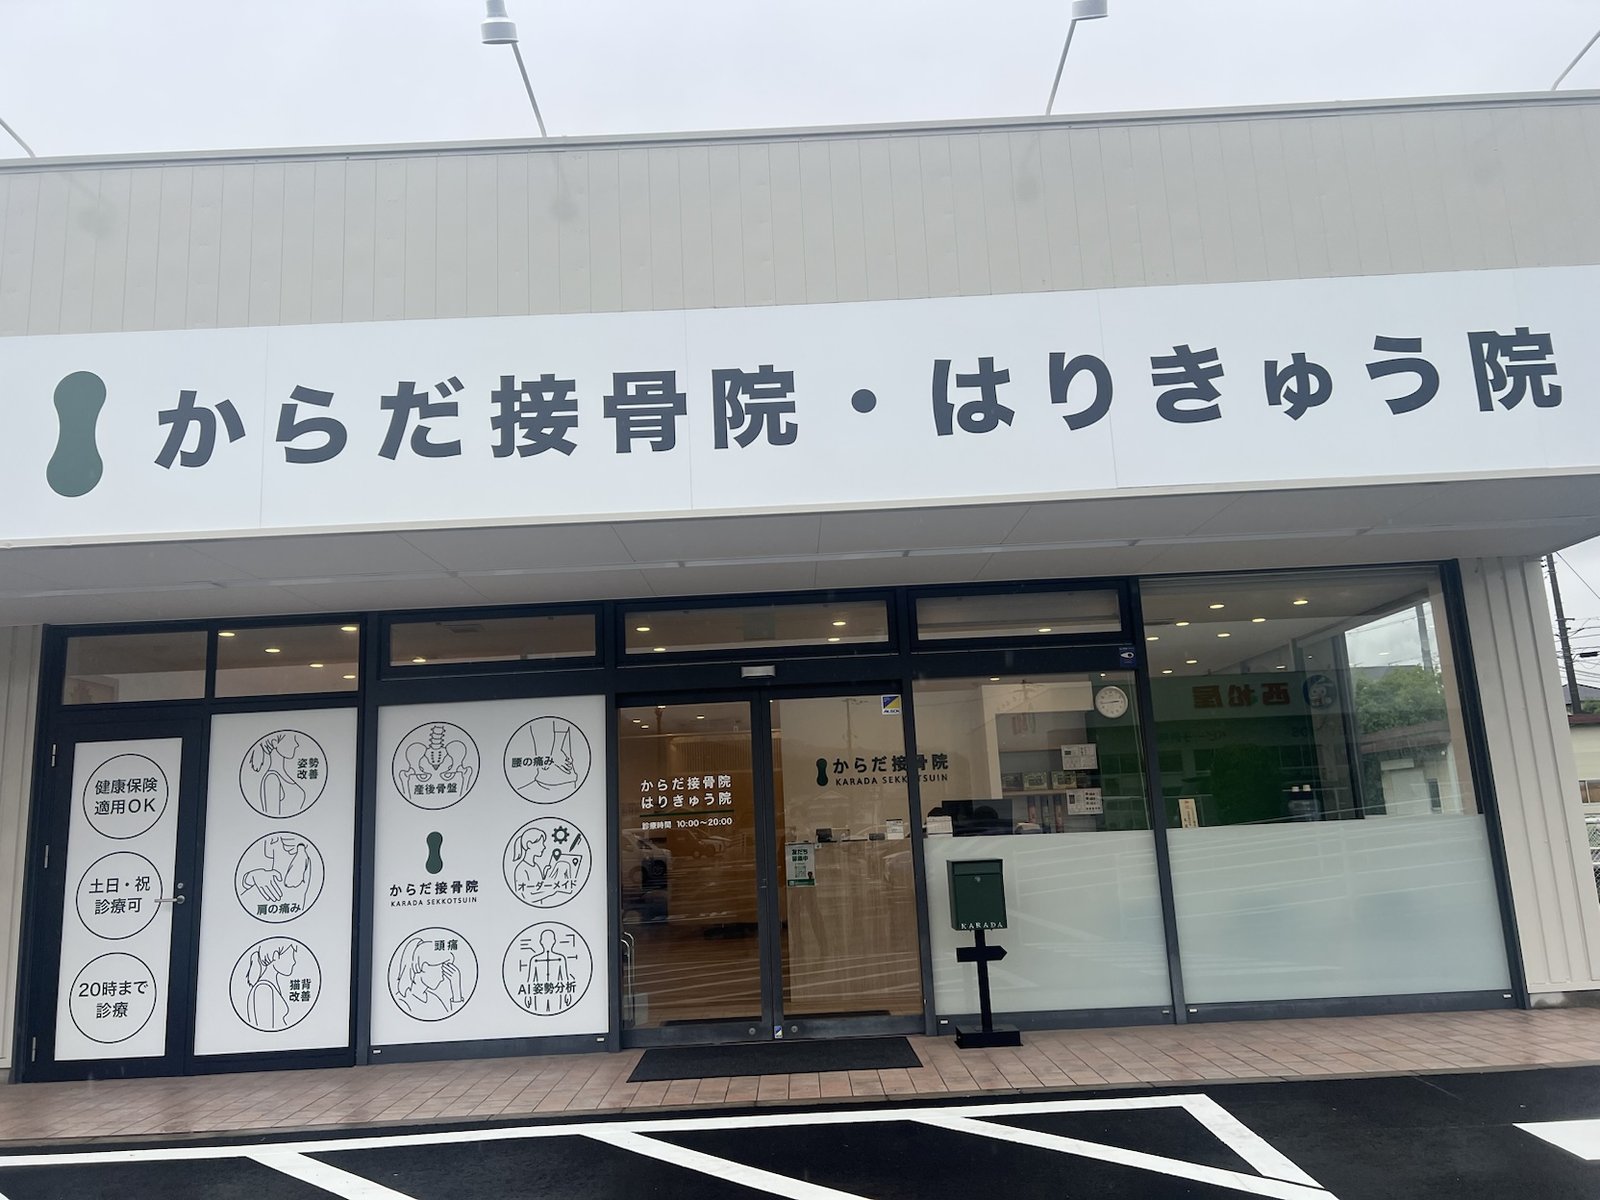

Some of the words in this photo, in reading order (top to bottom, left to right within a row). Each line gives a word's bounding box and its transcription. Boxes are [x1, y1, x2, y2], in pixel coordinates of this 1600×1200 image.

[154, 326, 1563, 471] からだ接骨院・はりきゅう院
[297, 757, 319, 768] 姿勢
[511, 756, 555, 769] 腰の痛み
[297, 769, 319, 780] 改善
[835, 777, 878, 786] KARADA
[882, 773, 949, 784] SEKKTSUIN
[94, 777, 158, 795] 健康保険
[413, 783, 458, 795] 産後骨盤
[641, 775, 731, 792] からだ接骨院
[93, 798, 156, 816] 適用OK
[641, 792, 732, 809] はりきゅう院
[642, 821, 672, 830] 診療時間
[88, 876, 151, 895] 土日・祝
[389, 880, 479, 897] からだ接骨院
[517, 880, 577, 892] オーダーメイド
[94, 898, 143, 916] 診療可
[390, 899, 423, 907] KARADA
[426, 897, 477, 905] SEKKOTSUIN
[256, 903, 302, 916] 肩の痛み
[961, 921, 1003, 929] KARADA
[434, 939, 458, 952] 頭痛
[78, 980, 149, 998] 20時まで
[289, 979, 311, 990] 猫背
[288, 990, 311, 1002] 改善
[96, 1003, 129, 1019] 診療
